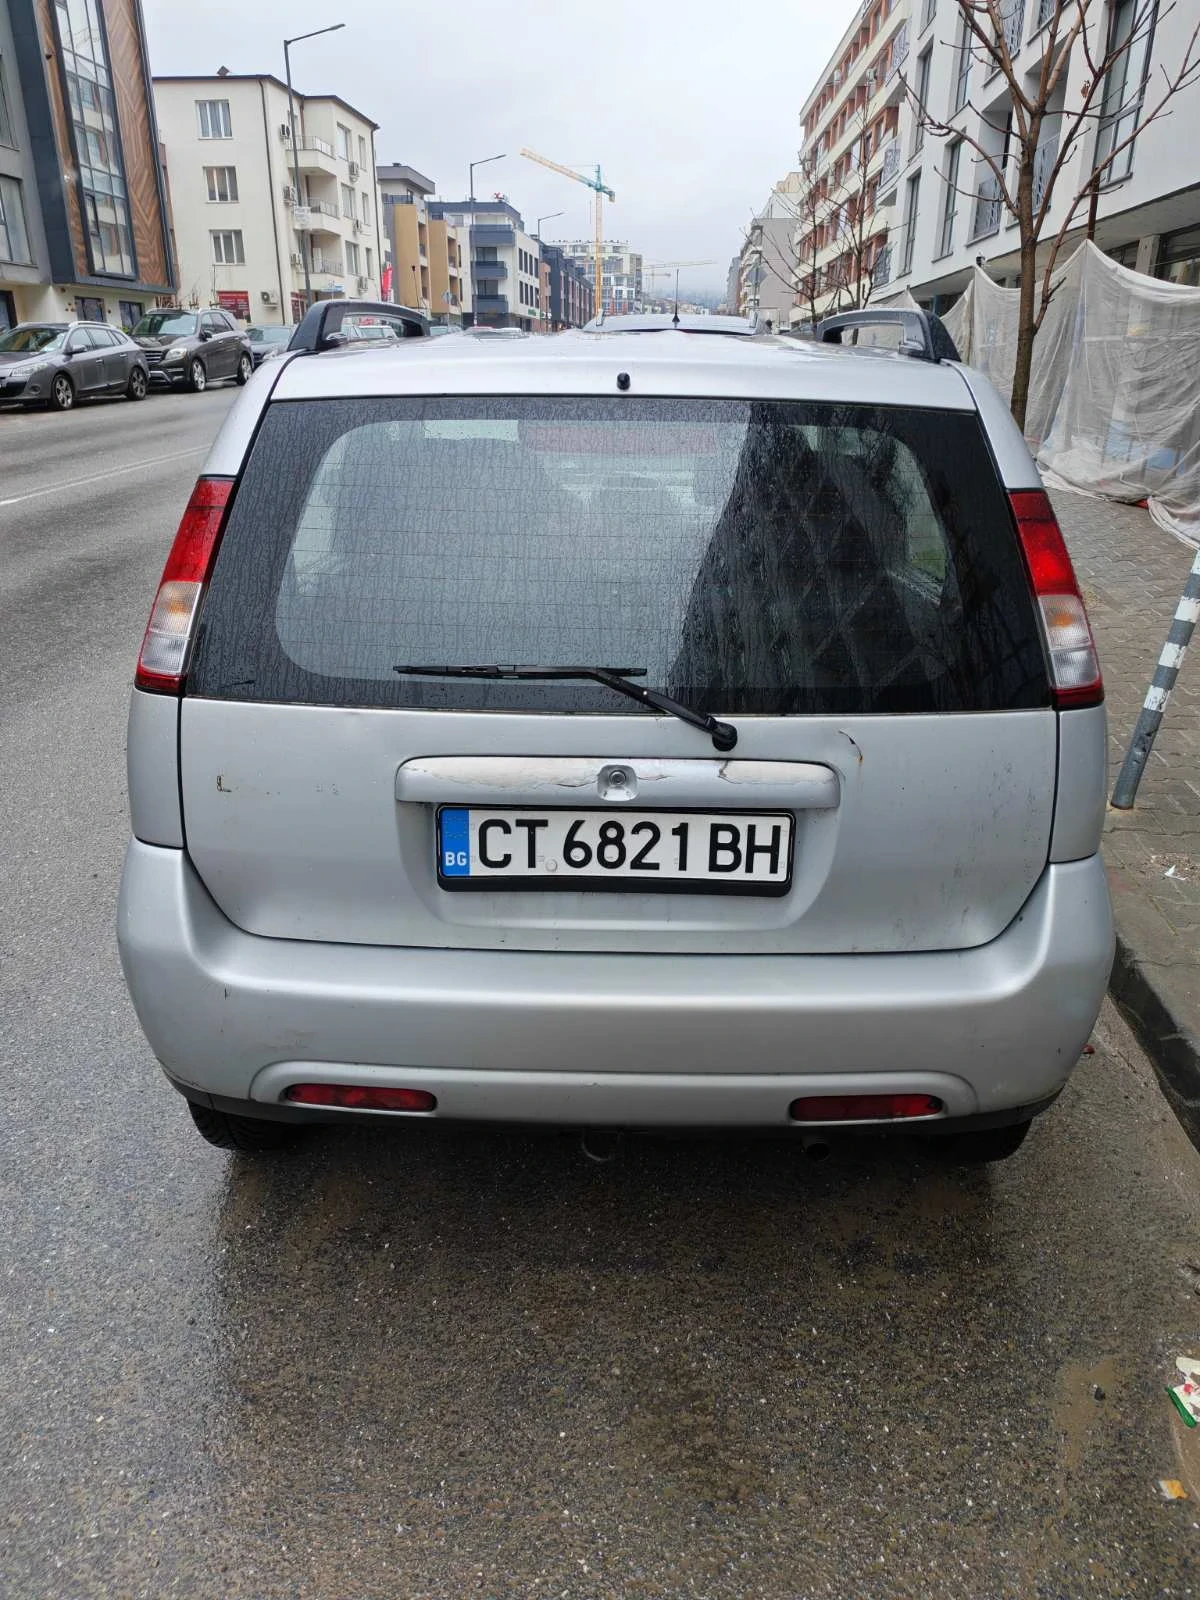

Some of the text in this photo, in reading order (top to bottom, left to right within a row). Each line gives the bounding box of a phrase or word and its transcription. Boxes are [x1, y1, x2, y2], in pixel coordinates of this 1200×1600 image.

[445, 851, 467, 866] BG
[478, 819, 781, 874] CT 6821 BH
